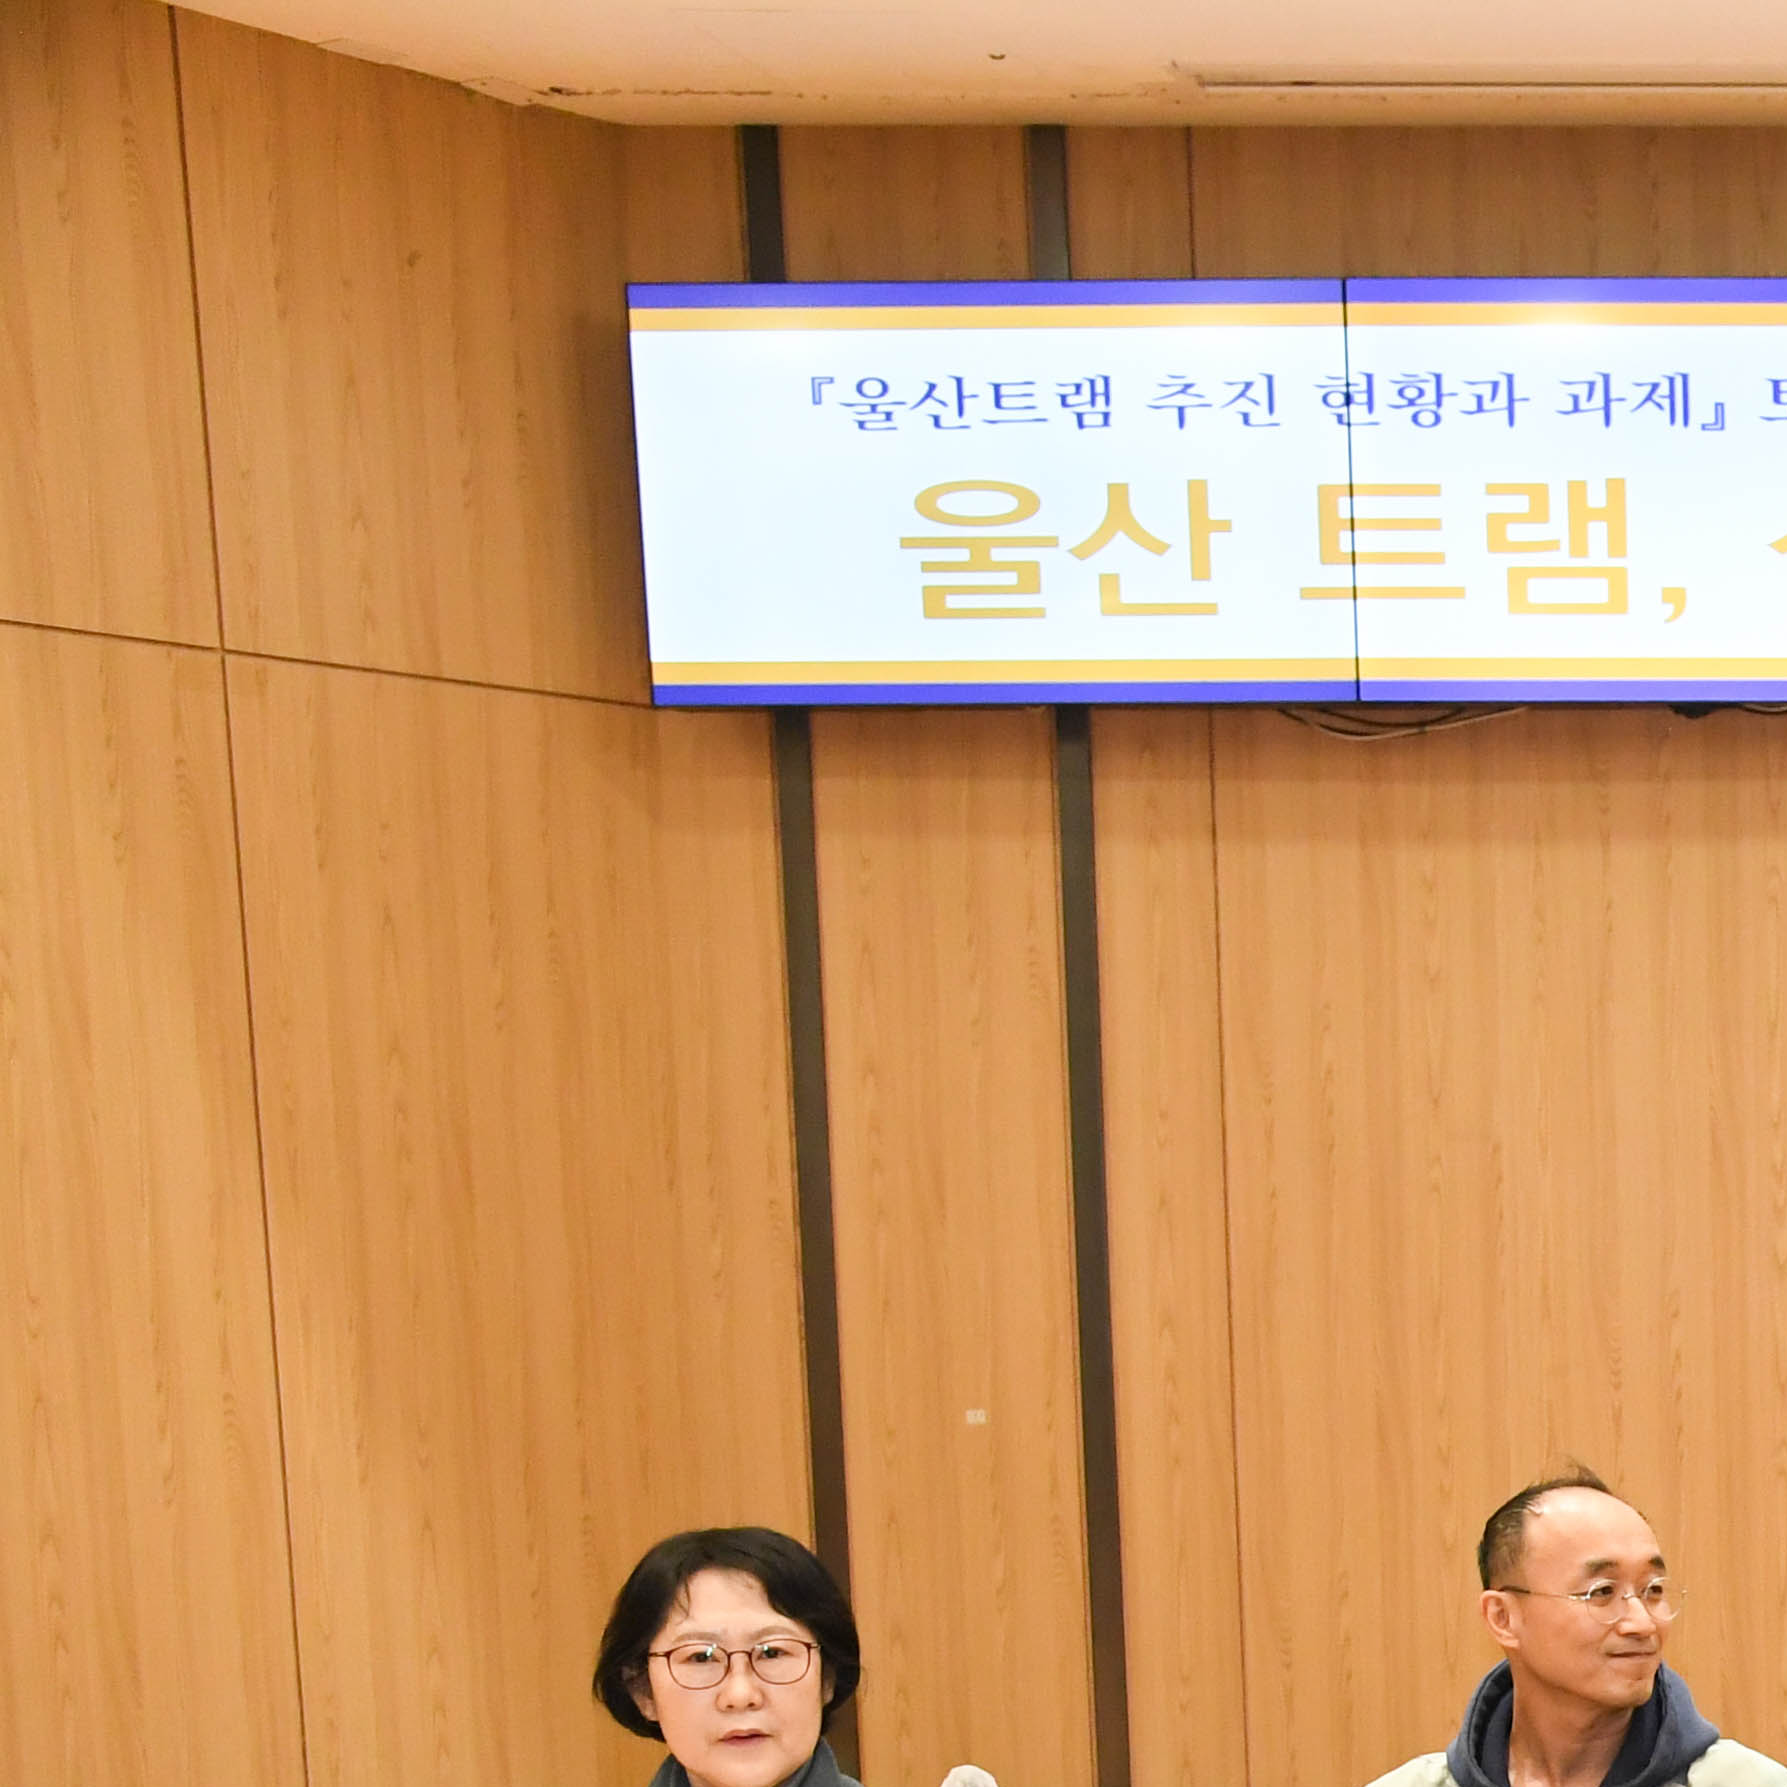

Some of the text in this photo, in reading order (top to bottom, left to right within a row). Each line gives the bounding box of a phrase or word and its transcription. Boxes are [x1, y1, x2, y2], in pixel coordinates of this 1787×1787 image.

[811, 374, 1111, 431] 『울산트램
[1147, 373, 1280, 430] 추진
[1315, 373, 1530, 431] 현황과
[1557, 372, 1725, 431] 과제』
[899, 479, 1232, 619] 울산
[1299, 479, 1686, 625] 트램,
